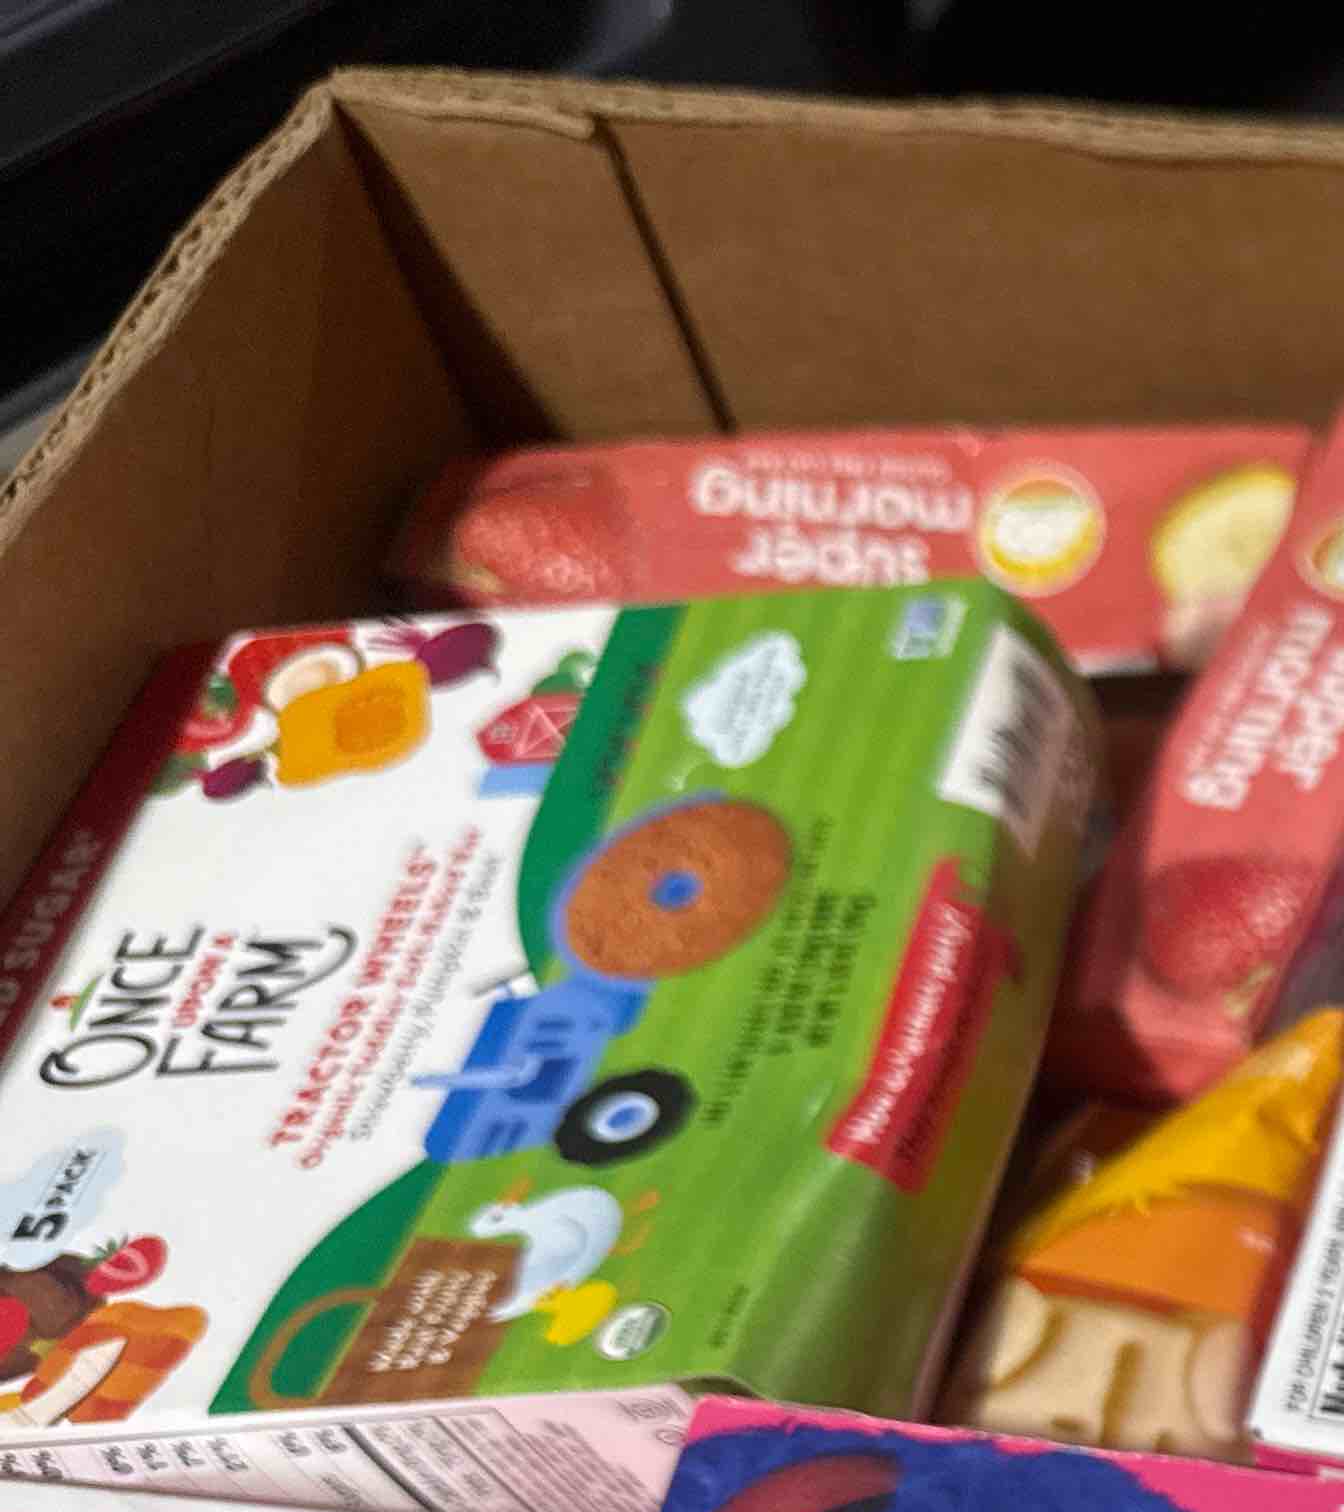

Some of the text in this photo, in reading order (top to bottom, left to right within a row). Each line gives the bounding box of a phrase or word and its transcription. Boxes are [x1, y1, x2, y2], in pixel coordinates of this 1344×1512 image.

[689, 466, 974, 531] morning
[727, 530, 932, 586] super
[1178, 601, 1335, 812] morning
[40, 924, 203, 1089] ONCE
[156, 924, 358, 1079] FARM
[170, 952, 223, 1028] UPON
[266, 995, 368, 1149] TRACTOR
[10, 1145, 98, 1243] 5 PACK
